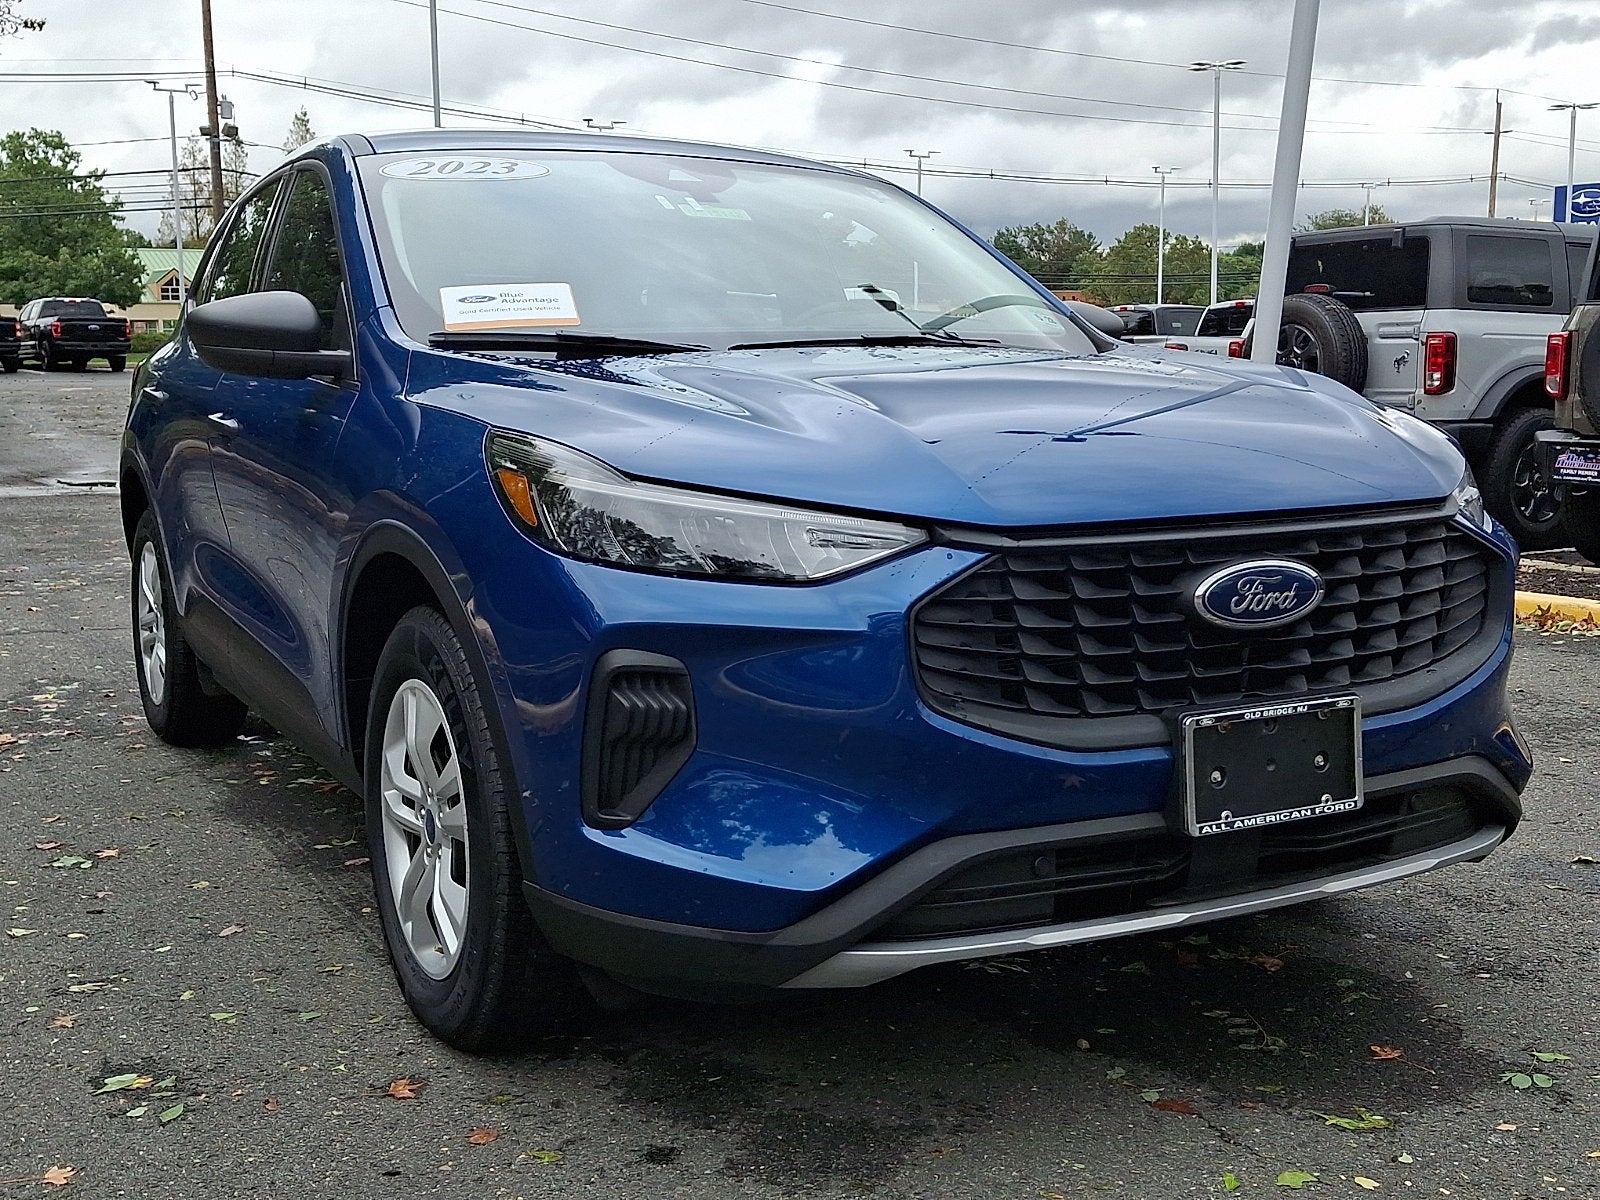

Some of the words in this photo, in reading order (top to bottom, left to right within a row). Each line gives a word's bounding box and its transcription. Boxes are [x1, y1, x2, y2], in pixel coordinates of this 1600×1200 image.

[407, 160, 519, 175] 2023
[1230, 575, 1299, 614] Ford
[1244, 711, 1262, 720] OLD
[1297, 705, 1308, 713] NJ
[1201, 823, 1231, 834] ALL
[1233, 808, 1312, 828] AMERICAN
[1315, 801, 1355, 814] FORD
